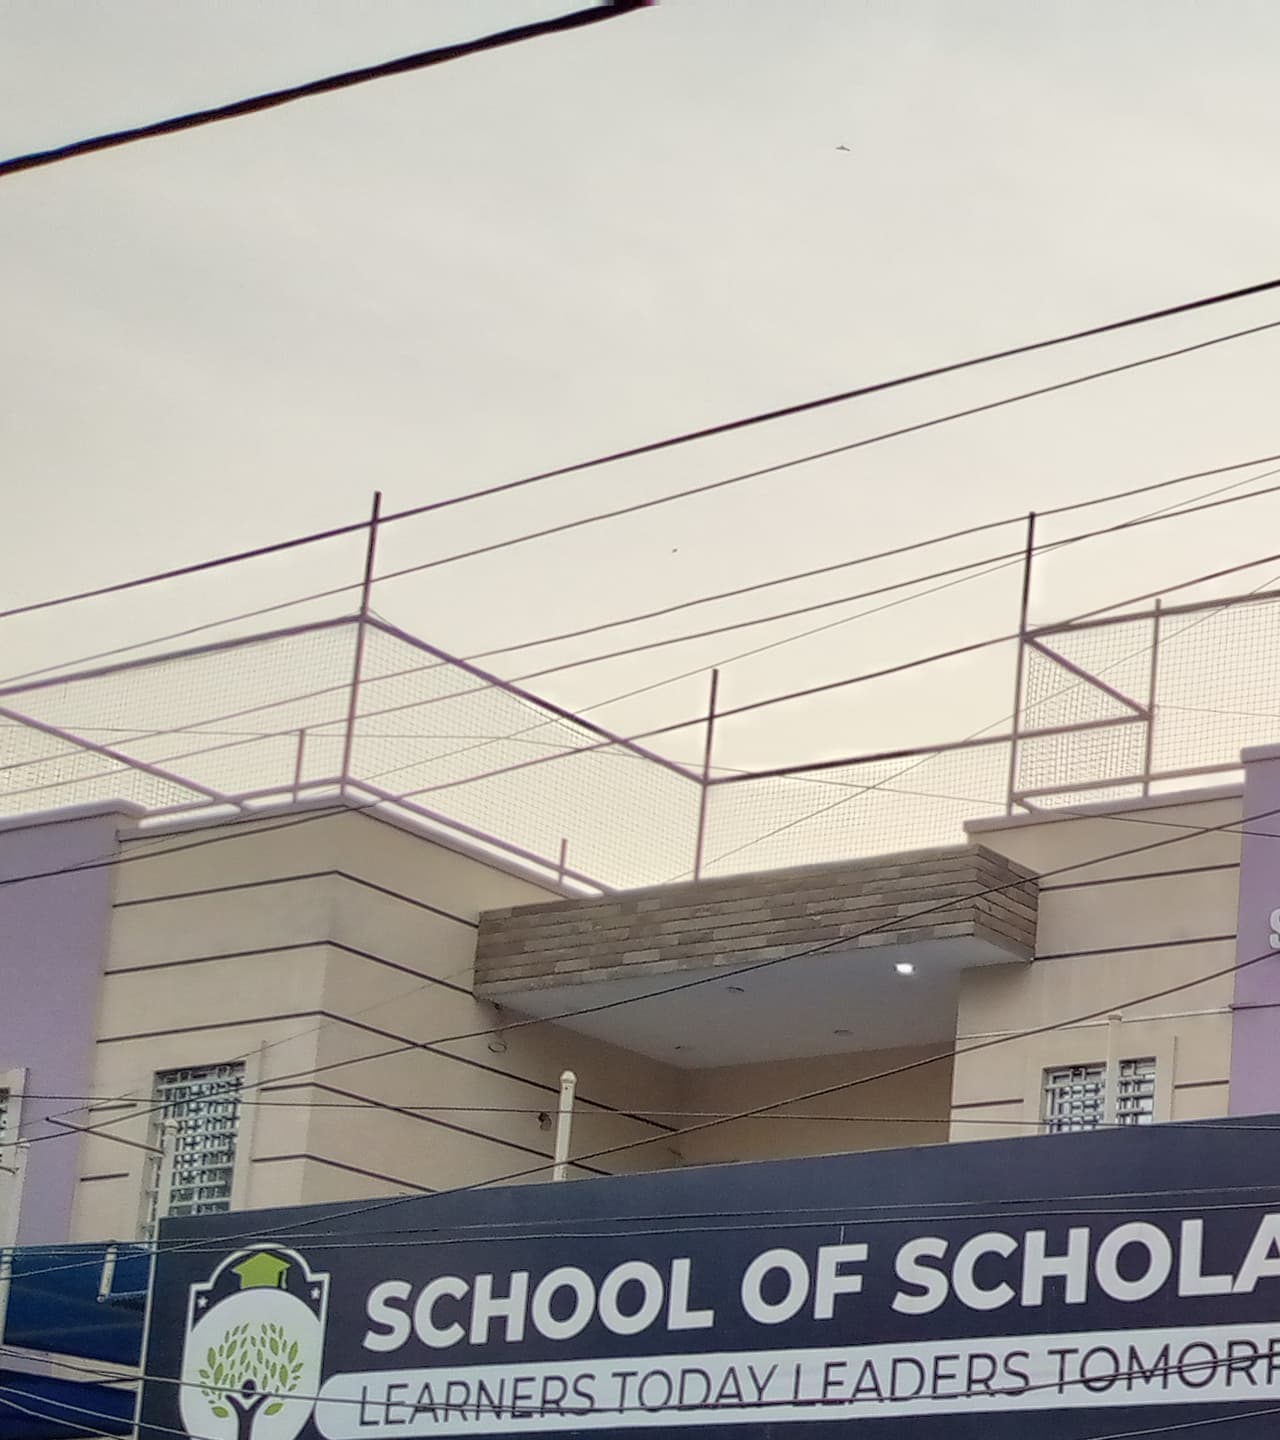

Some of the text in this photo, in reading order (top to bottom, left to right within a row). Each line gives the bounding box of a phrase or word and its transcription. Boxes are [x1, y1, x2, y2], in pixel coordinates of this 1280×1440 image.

[362, 1257, 715, 1353] SCHOOL
[741, 1242, 869, 1325] OF
[358, 1373, 596, 1427] LEARNERS
[610, 1364, 779, 1415] TODAY
[794, 1350, 1030, 1407] LEADERS
